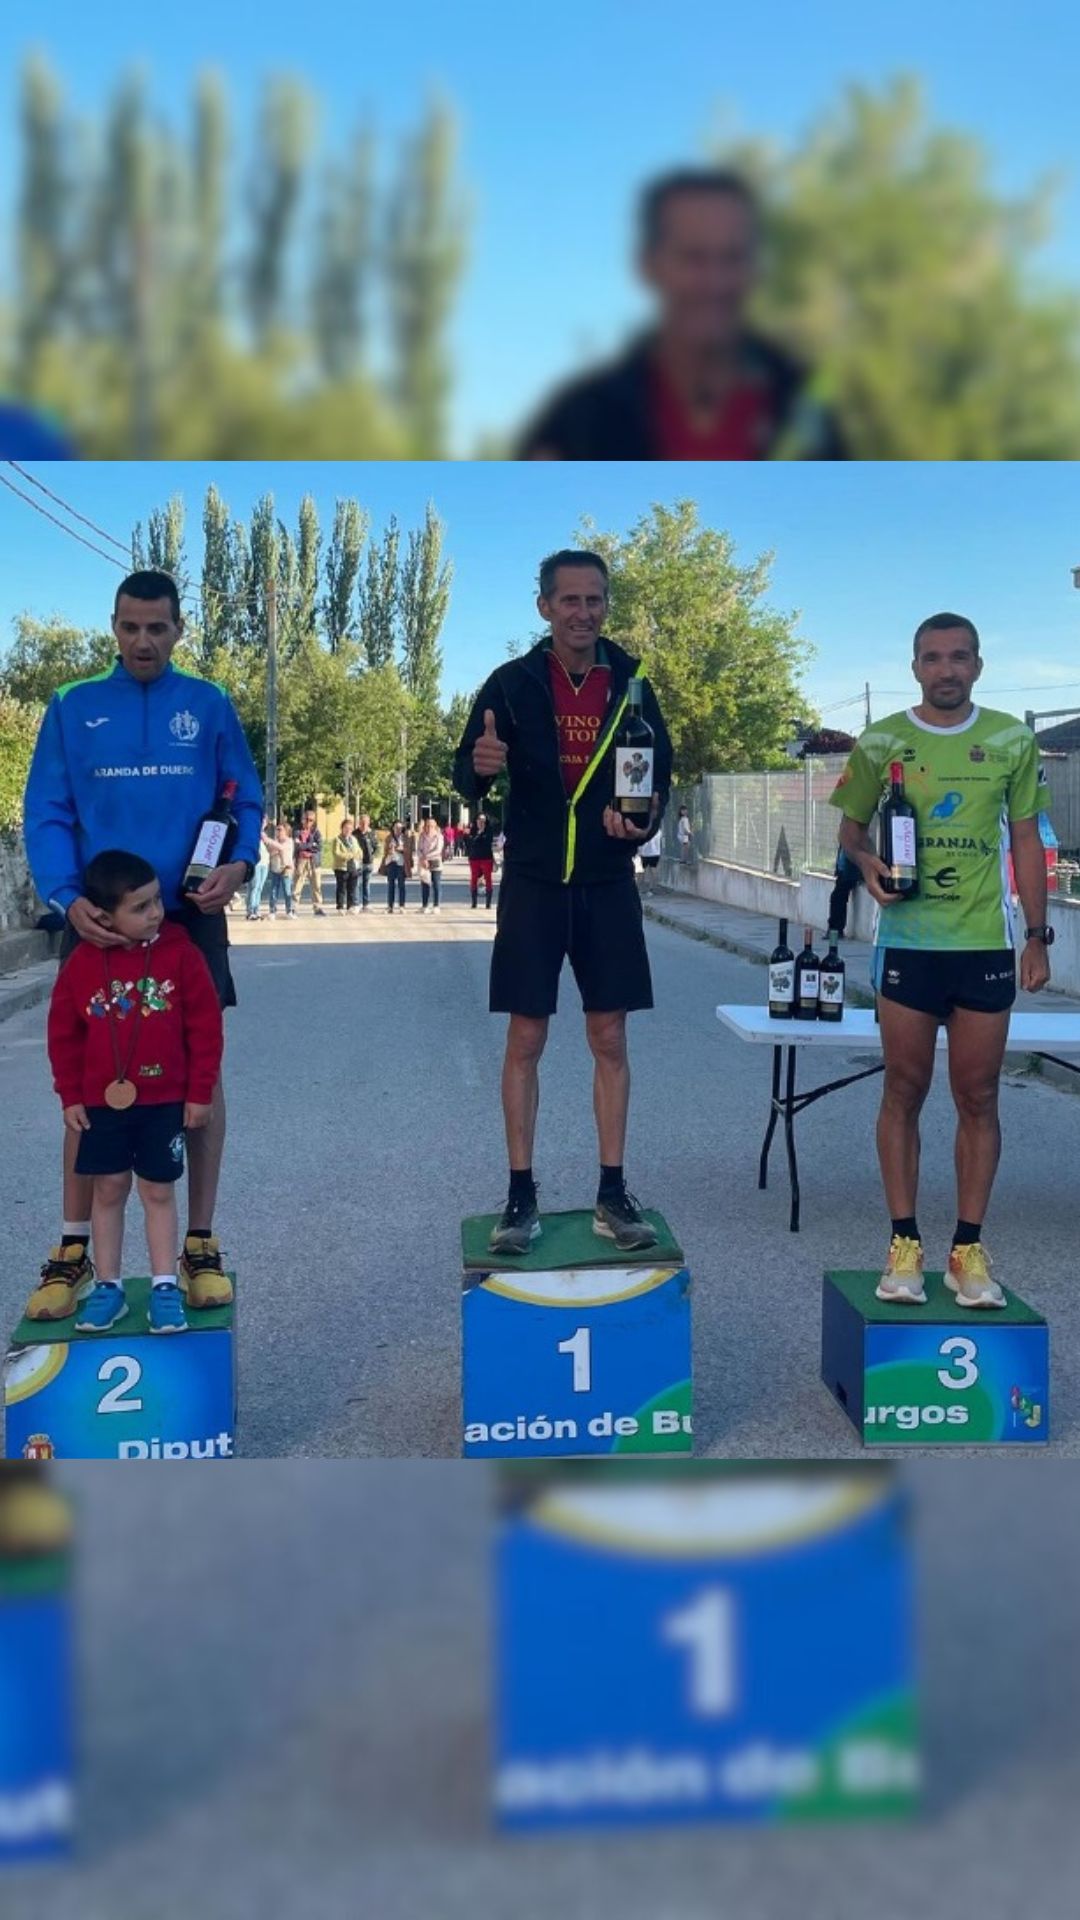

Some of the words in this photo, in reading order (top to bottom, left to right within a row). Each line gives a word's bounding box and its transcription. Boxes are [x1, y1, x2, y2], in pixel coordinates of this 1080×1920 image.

[554, 715, 601, 727] VINO
[94, 767, 140, 777] ARANDA
[142, 766, 158, 776] DE
[558, 1327, 591, 1392] 1
[937, 1336, 979, 1389] 3
[97, 1355, 142, 1413] 2
[464, 1414, 577, 1443] ación
[588, 1412, 639, 1437] de
